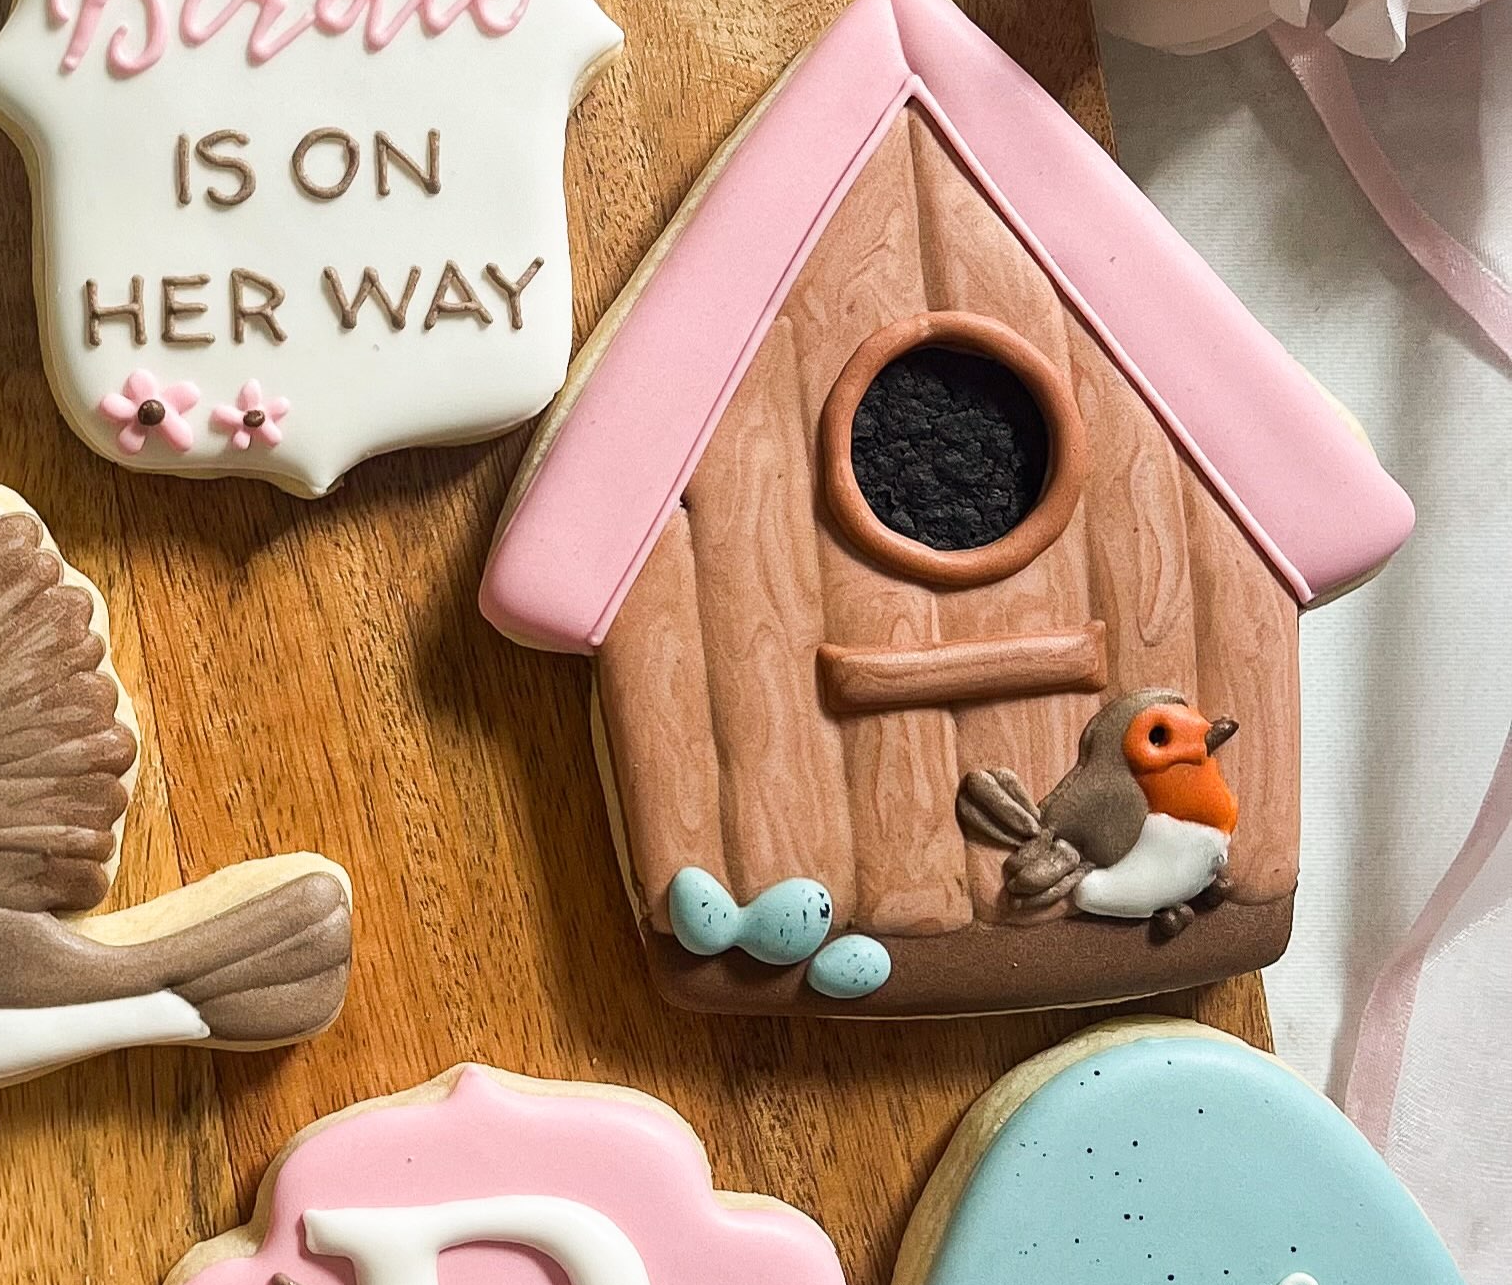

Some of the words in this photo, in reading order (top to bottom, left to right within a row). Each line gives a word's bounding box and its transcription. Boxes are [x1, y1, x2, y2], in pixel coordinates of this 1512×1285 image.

[175, 127, 257, 207] IS
[291, 127, 442, 202] ON
[83, 265, 288, 347] HER
[320, 256, 545, 331] WAY
